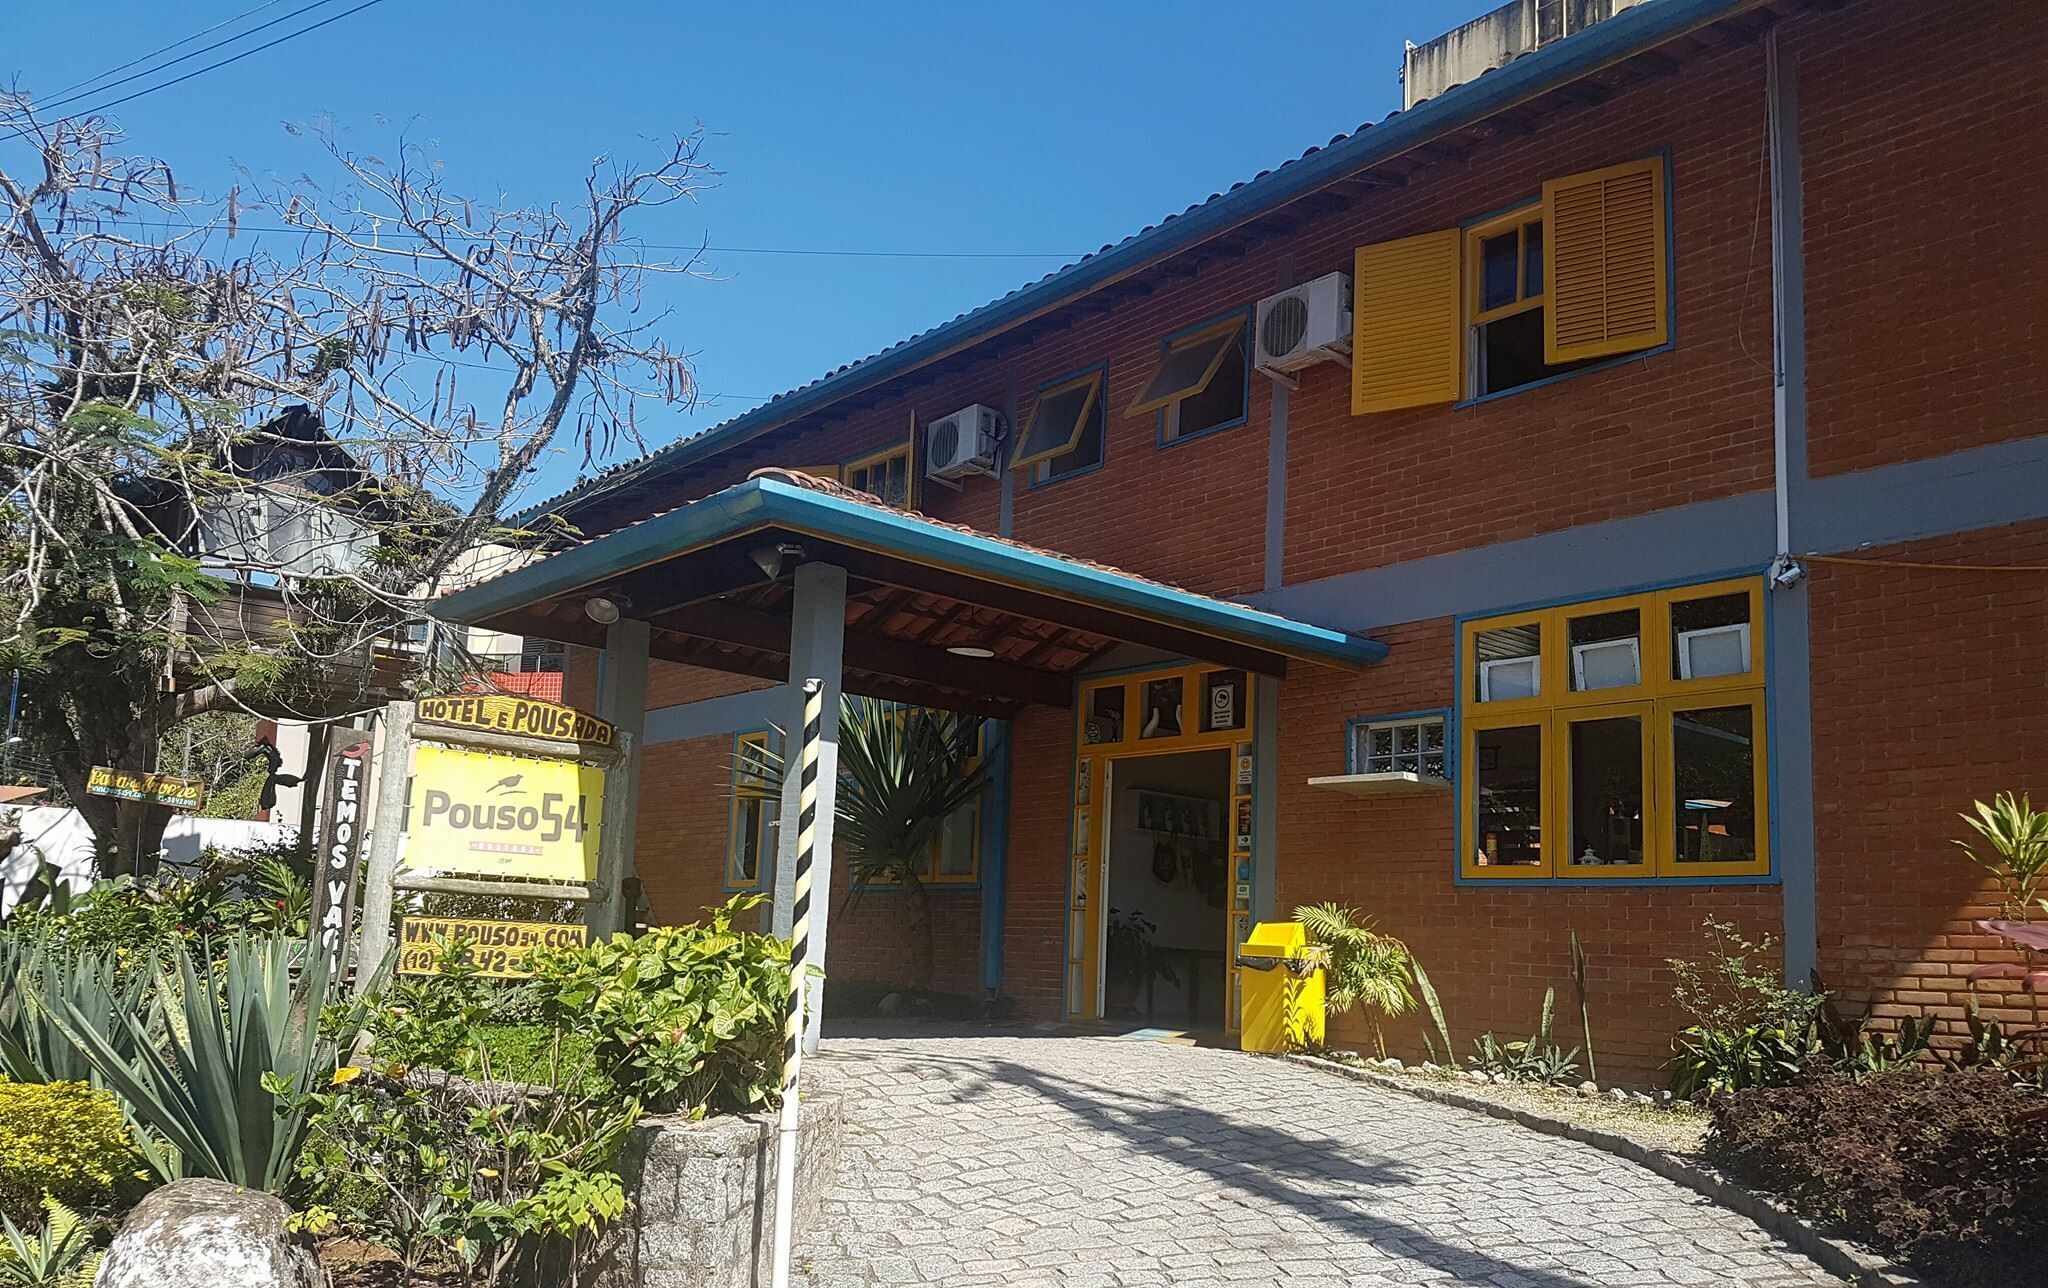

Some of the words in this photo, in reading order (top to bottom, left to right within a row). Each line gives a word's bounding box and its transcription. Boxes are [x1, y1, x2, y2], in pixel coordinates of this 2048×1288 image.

[422, 699, 492, 725] HOTEL
[512, 701, 610, 743] POUSADA
[331, 758, 361, 869] TEMOS
[423, 789, 588, 842] Pouso54
[403, 949, 434, 971] (12)
